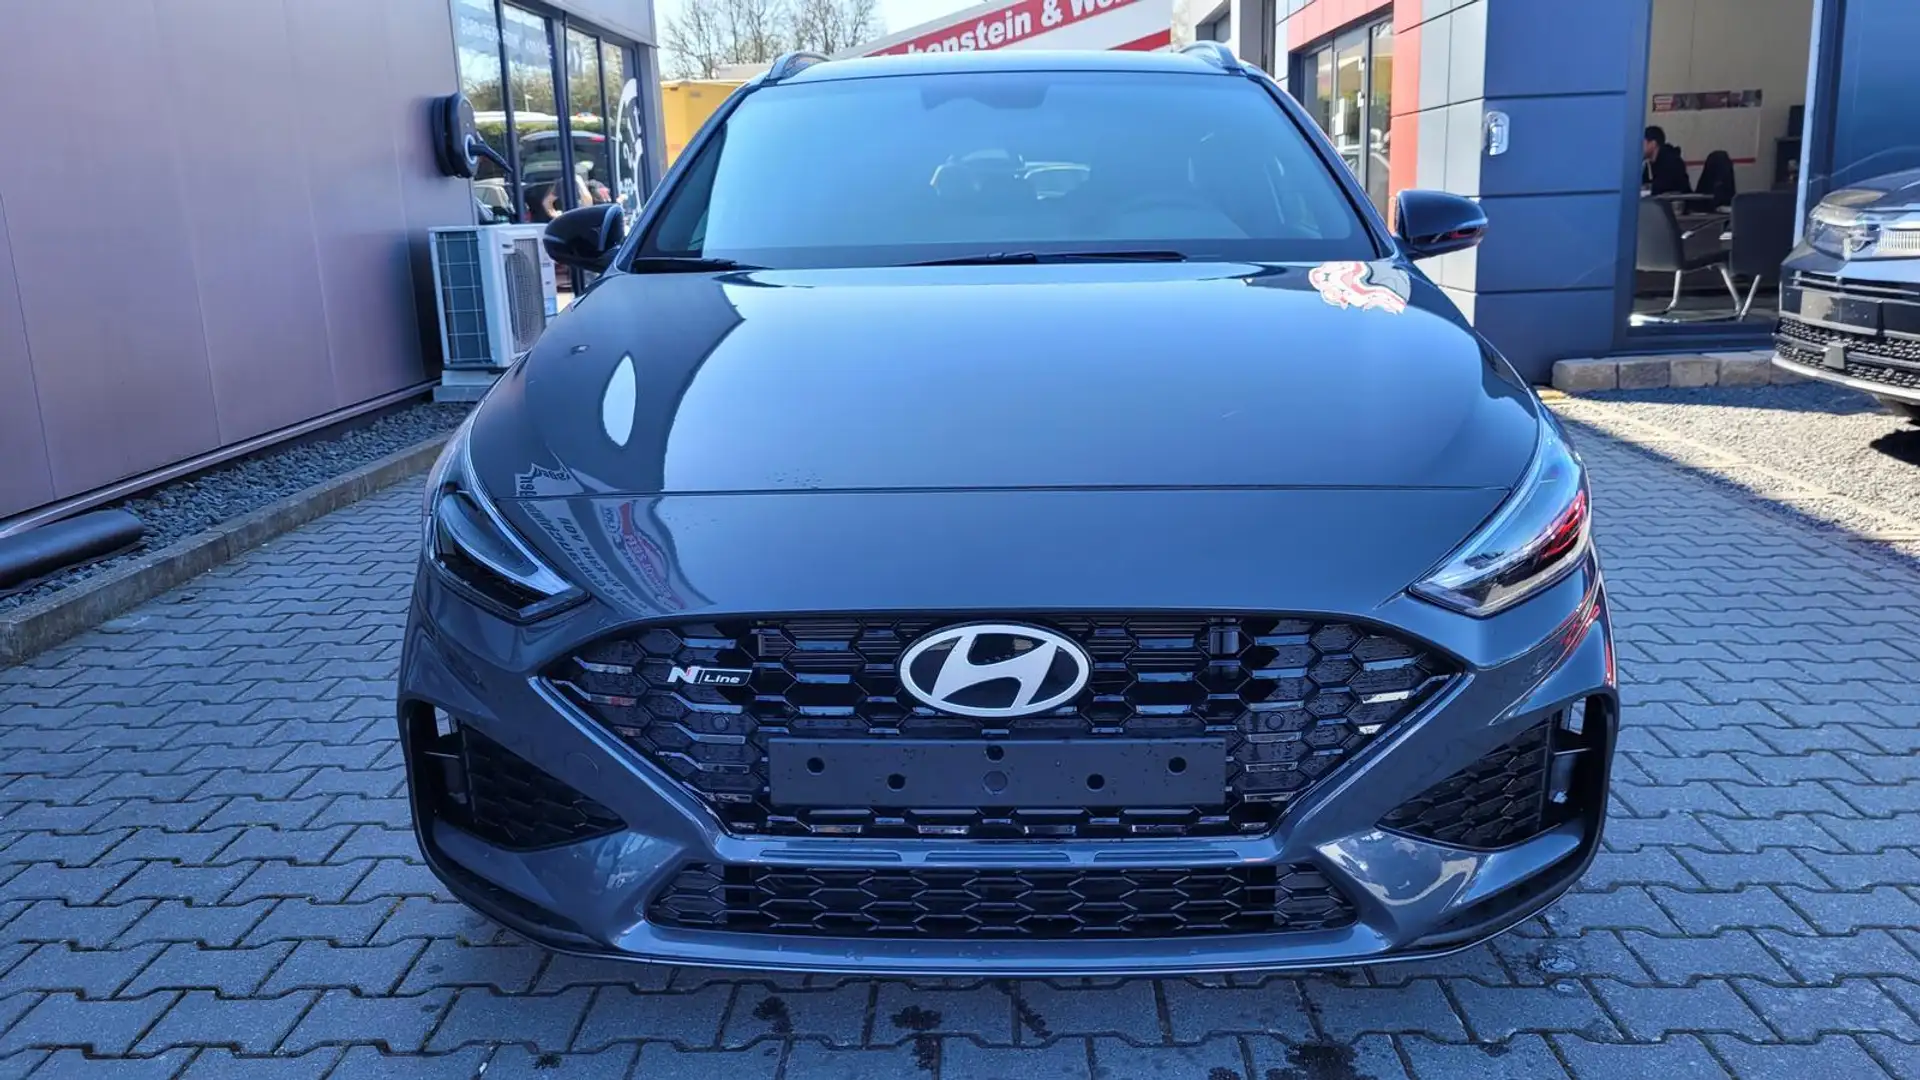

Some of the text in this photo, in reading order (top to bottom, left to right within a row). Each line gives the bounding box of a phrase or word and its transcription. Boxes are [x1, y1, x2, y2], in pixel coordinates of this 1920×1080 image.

[1041, 0, 1063, 27] &
[667, 666, 740, 684] N Line
